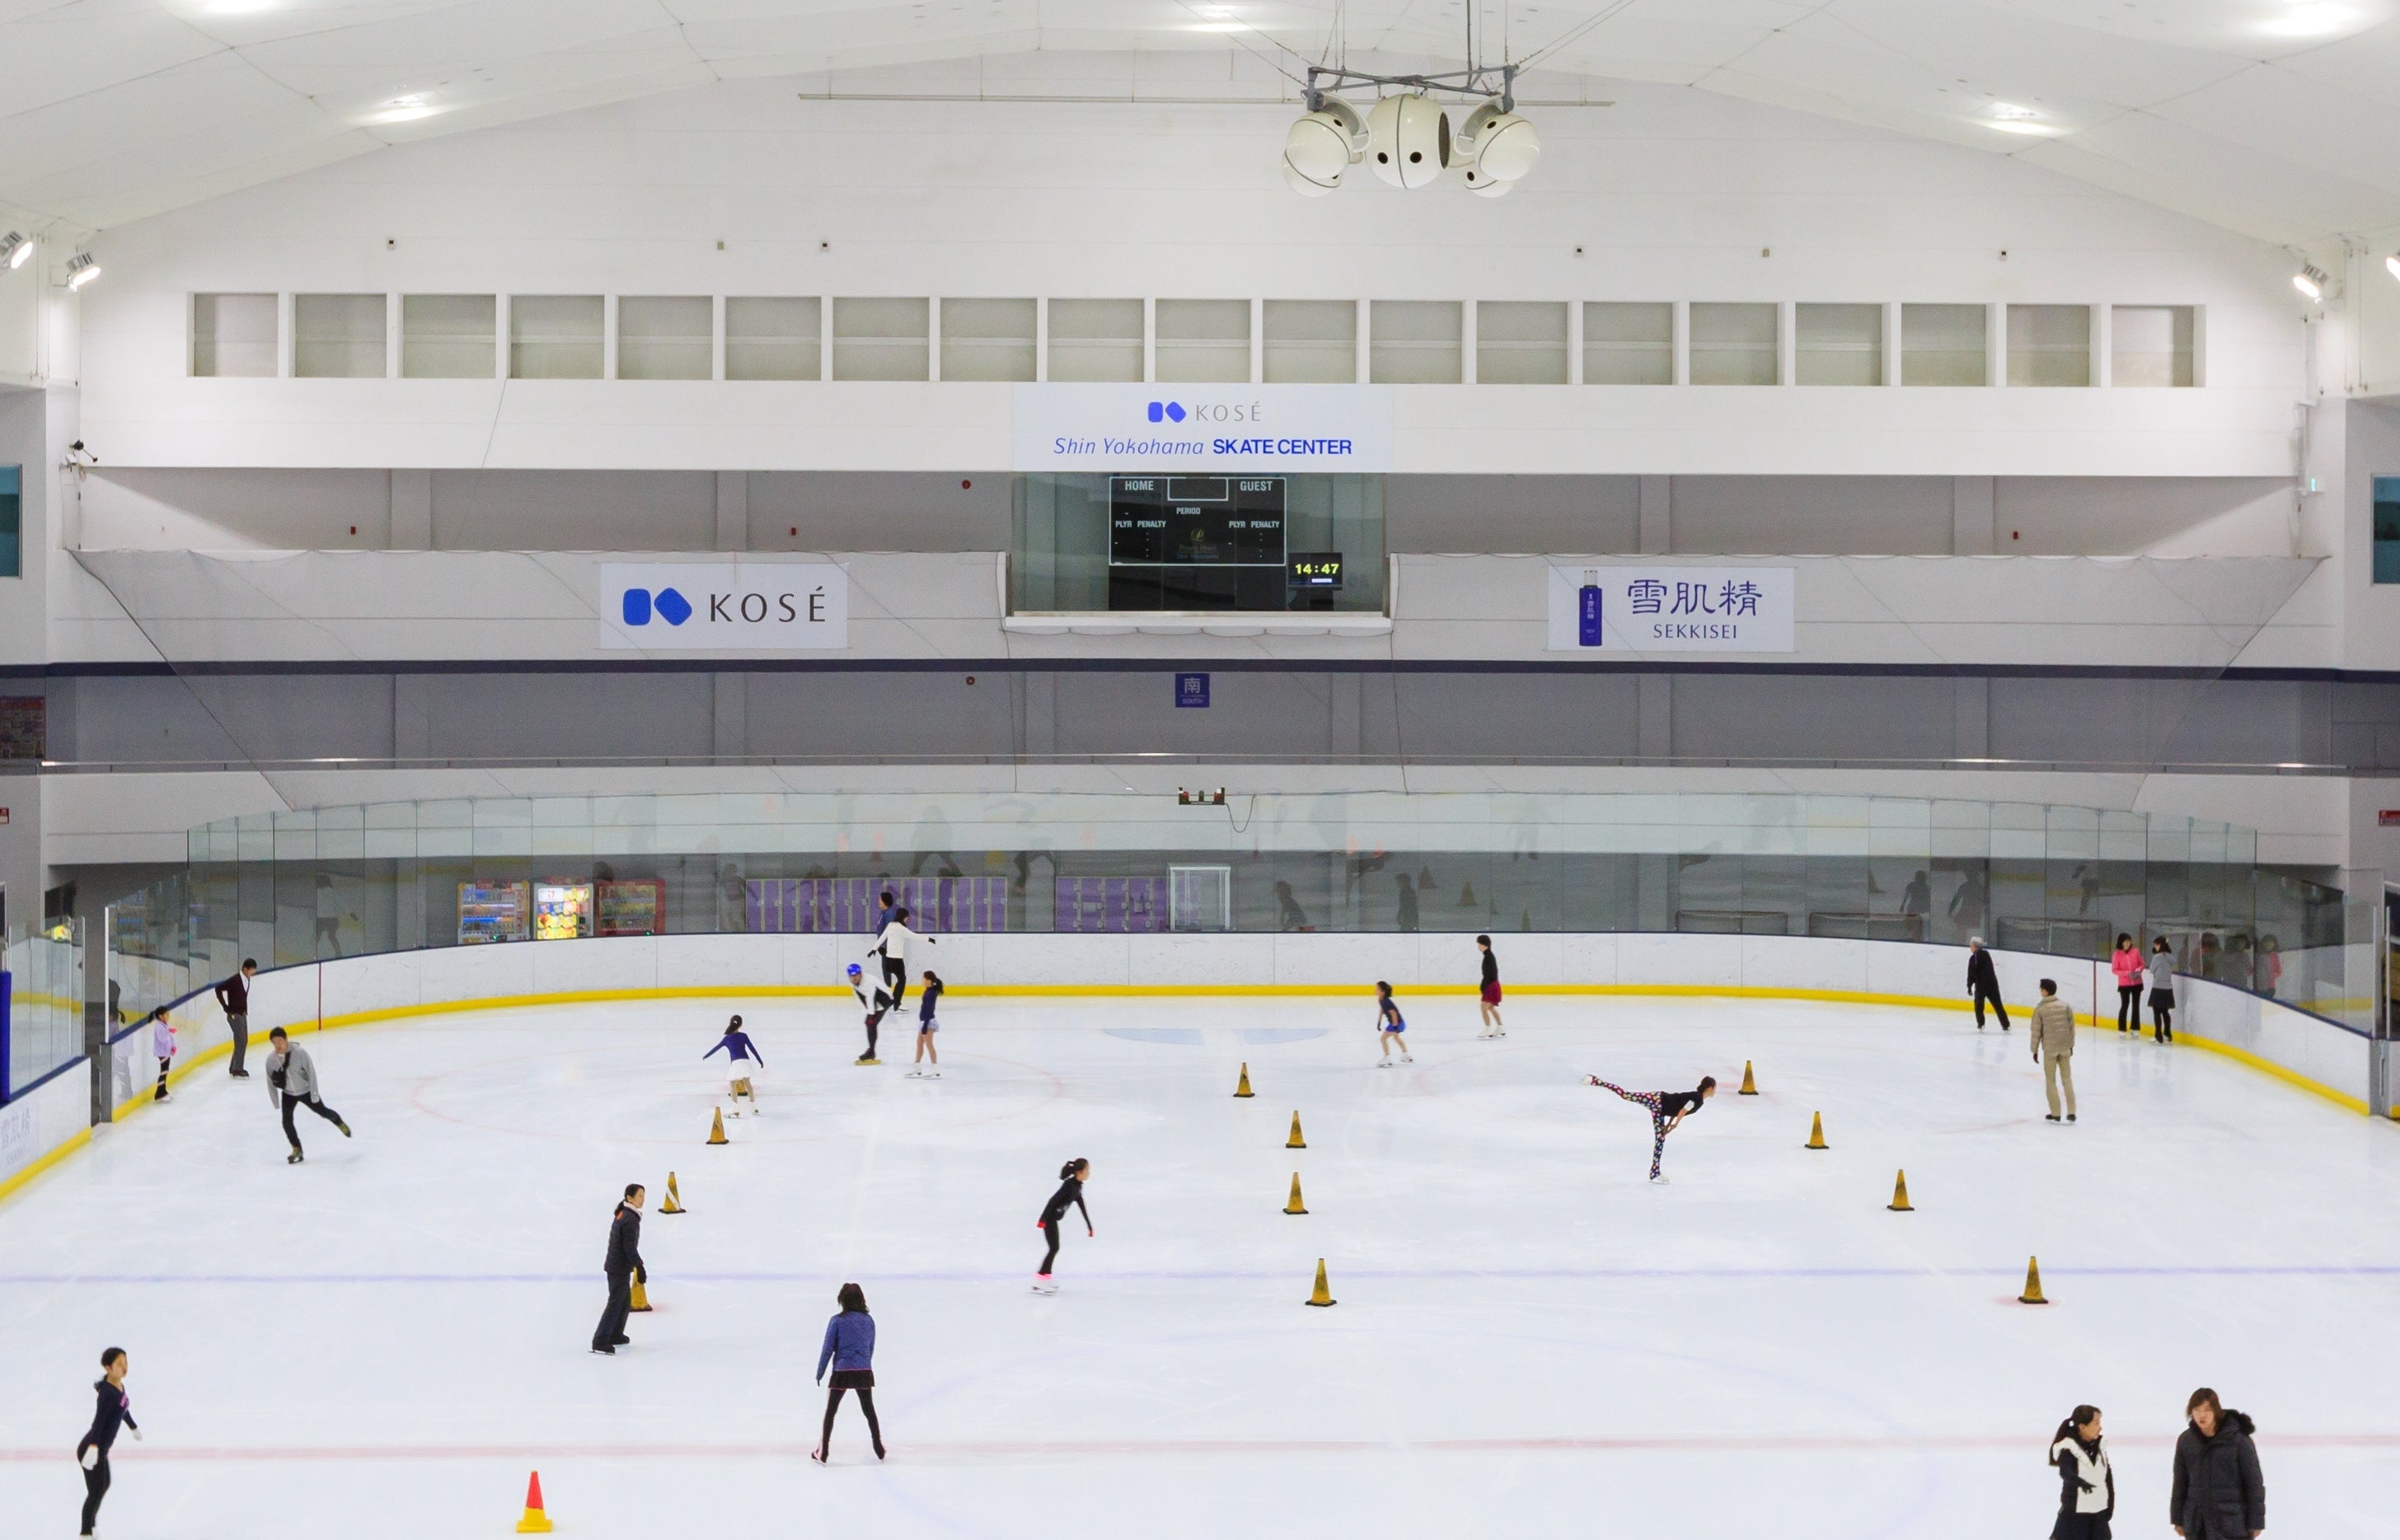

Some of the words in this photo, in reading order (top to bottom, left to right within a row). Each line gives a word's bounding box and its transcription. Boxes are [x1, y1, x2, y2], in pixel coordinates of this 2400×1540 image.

[1196, 400, 1261, 422] KOSÉ
[1053, 438, 1096, 454] Shin
[1103, 438, 1204, 455] Yokohama
[1213, 438, 1274, 455] SKATE
[1277, 438, 1352, 455] CENTER
[1124, 480, 1154, 491] HOME
[1240, 480, 1273, 492] GUEST
[1176, 507, 1201, 515] PERIOD
[1115, 520, 1132, 528] PLYR
[1137, 520, 1166, 528] PENALTY
[1295, 563, 1339, 575] 14:47
[710, 586, 826, 623] KOSÉ
[1627, 579, 1763, 616] 雪肌精
[1652, 624, 1737, 639] SEKKISEI
[1184, 678, 1201, 694] 南
